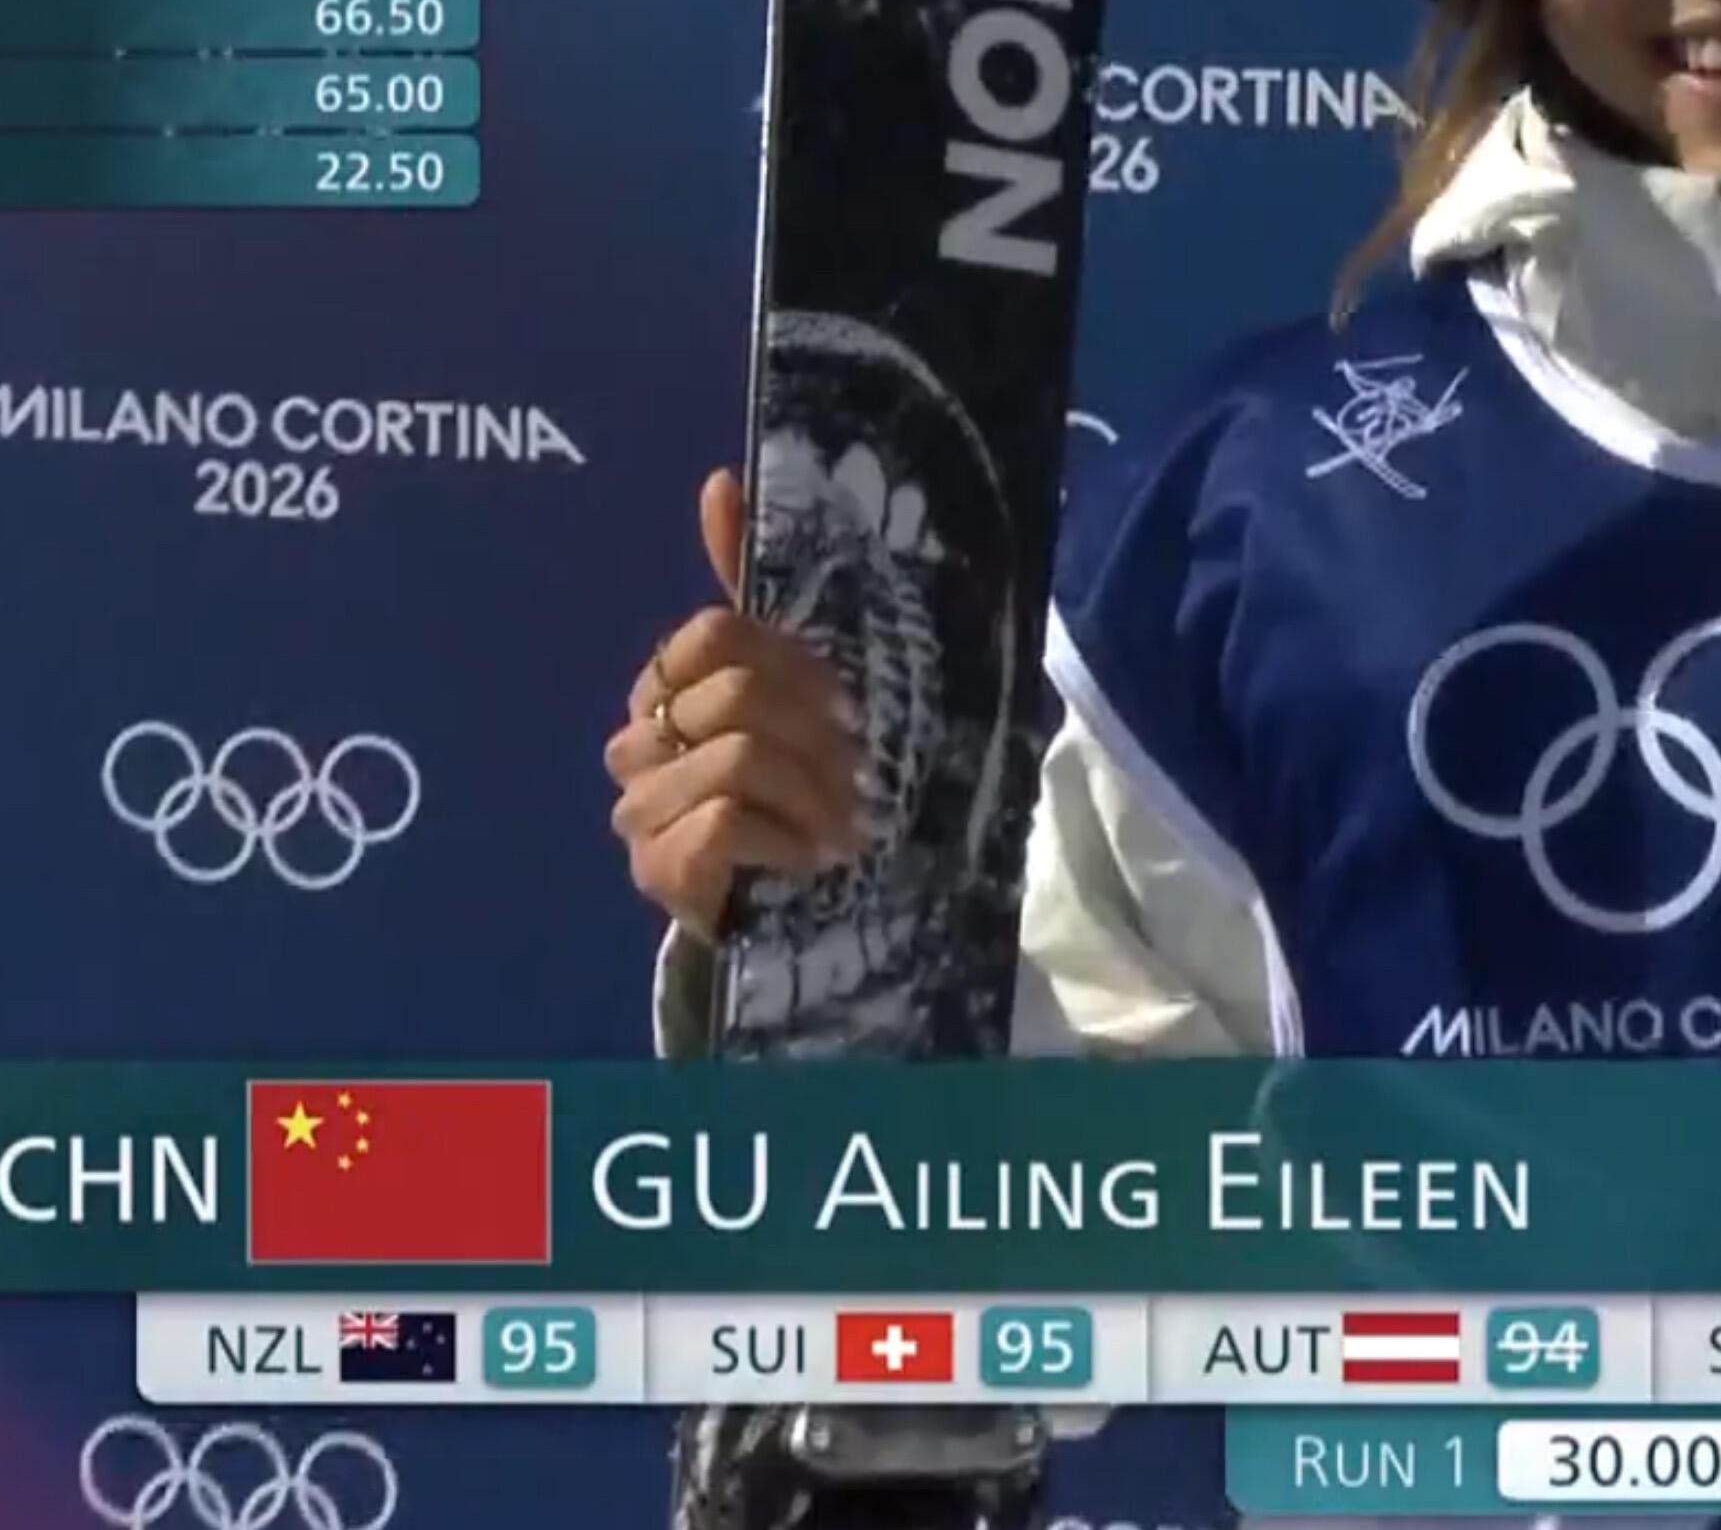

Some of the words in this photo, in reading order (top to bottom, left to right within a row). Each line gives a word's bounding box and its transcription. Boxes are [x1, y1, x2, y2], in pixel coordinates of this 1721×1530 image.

[1094, 63, 1425, 131] CORTINA
[1089, 133, 1160, 193] 26
[0, 383, 257, 448] MILANO
[271, 396, 587, 464] CORTINA
[194, 460, 340, 520] 2026
[1403, 998, 1664, 1056] MILANO
